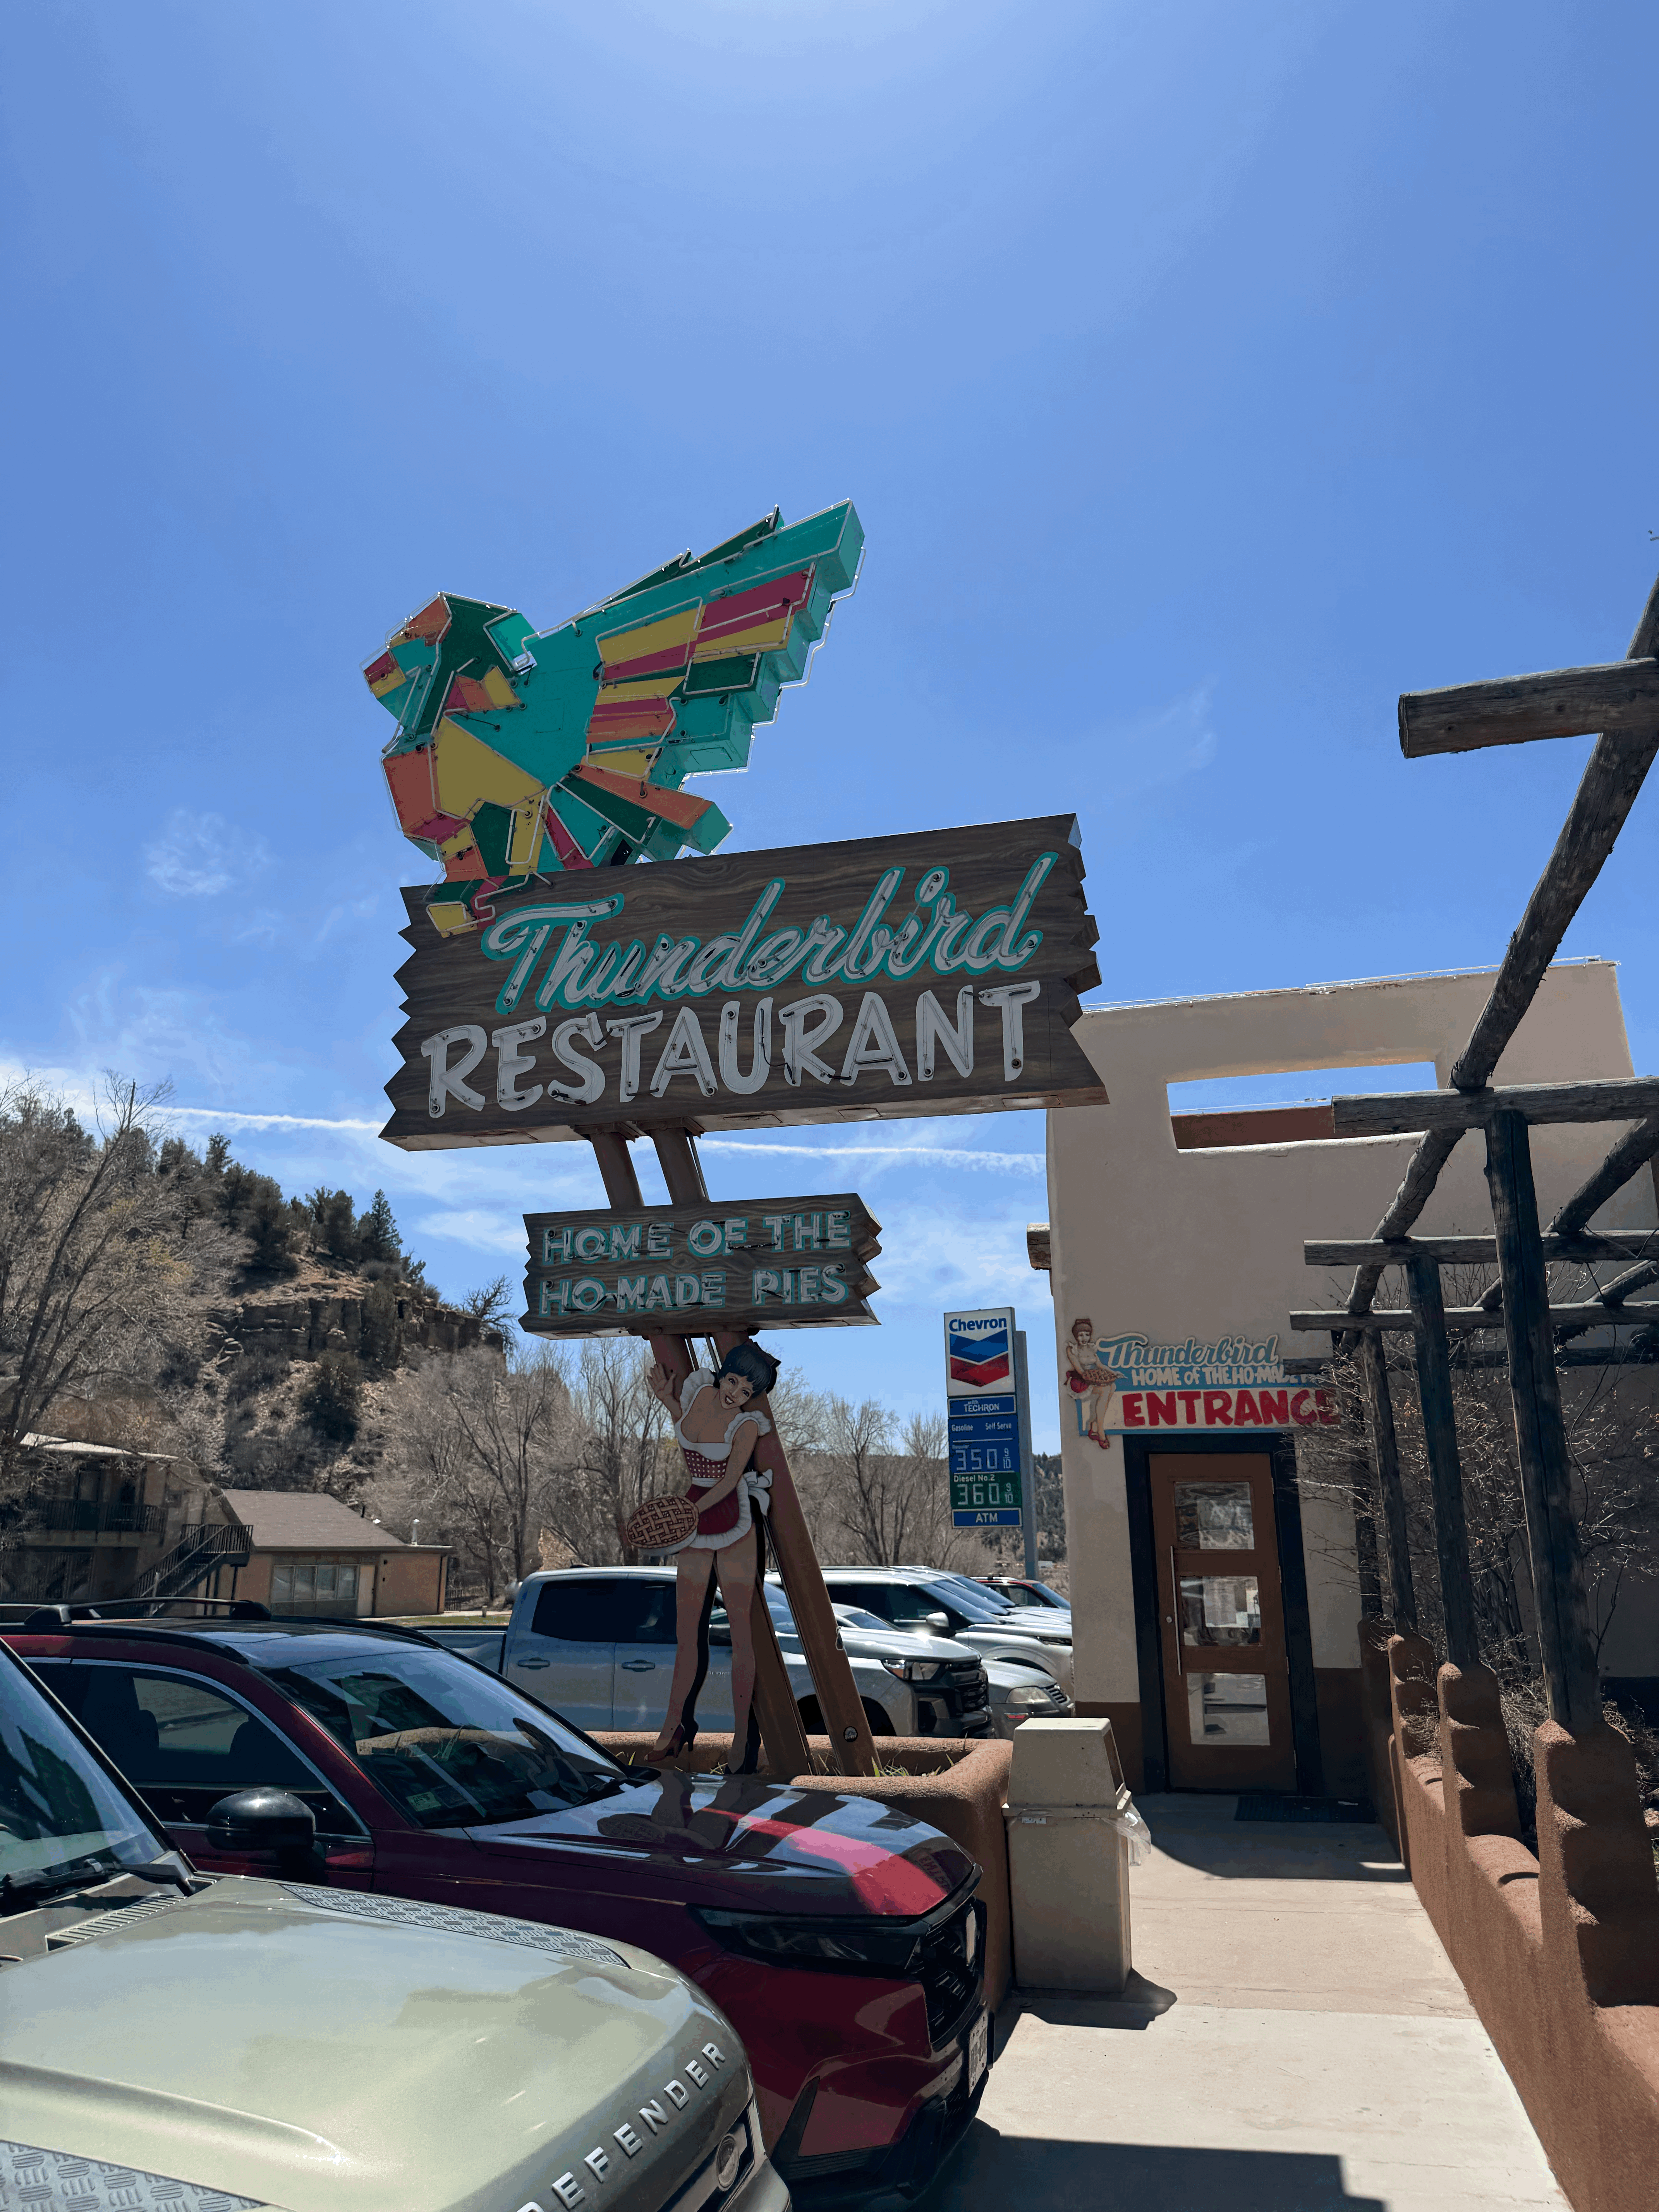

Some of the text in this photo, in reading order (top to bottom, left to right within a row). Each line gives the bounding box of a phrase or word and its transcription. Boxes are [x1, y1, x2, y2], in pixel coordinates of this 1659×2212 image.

[481, 852, 1059, 1015] Thunderbird
[421, 981, 1041, 1118] RESTAURANT
[543, 1210, 852, 1266] HOME OF THE
[752, 1263, 850, 1307] PIES
[949, 1317, 1007, 1332] Chevron
[1096, 1332, 1278, 1369] Thunderbird
[1131, 1366, 1182, 1386] HOME
[1202, 1366, 1232, 1385] THE
[963, 1403, 1000, 1413] TECHRON
[1122, 1389, 1341, 1427] ENTRANCE
[951, 1424, 974, 1432] Gasoline
[985, 1422, 996, 1431] Self
[953, 1474, 976, 1482] Diesel
[975, 1512, 998, 1523] ATM
